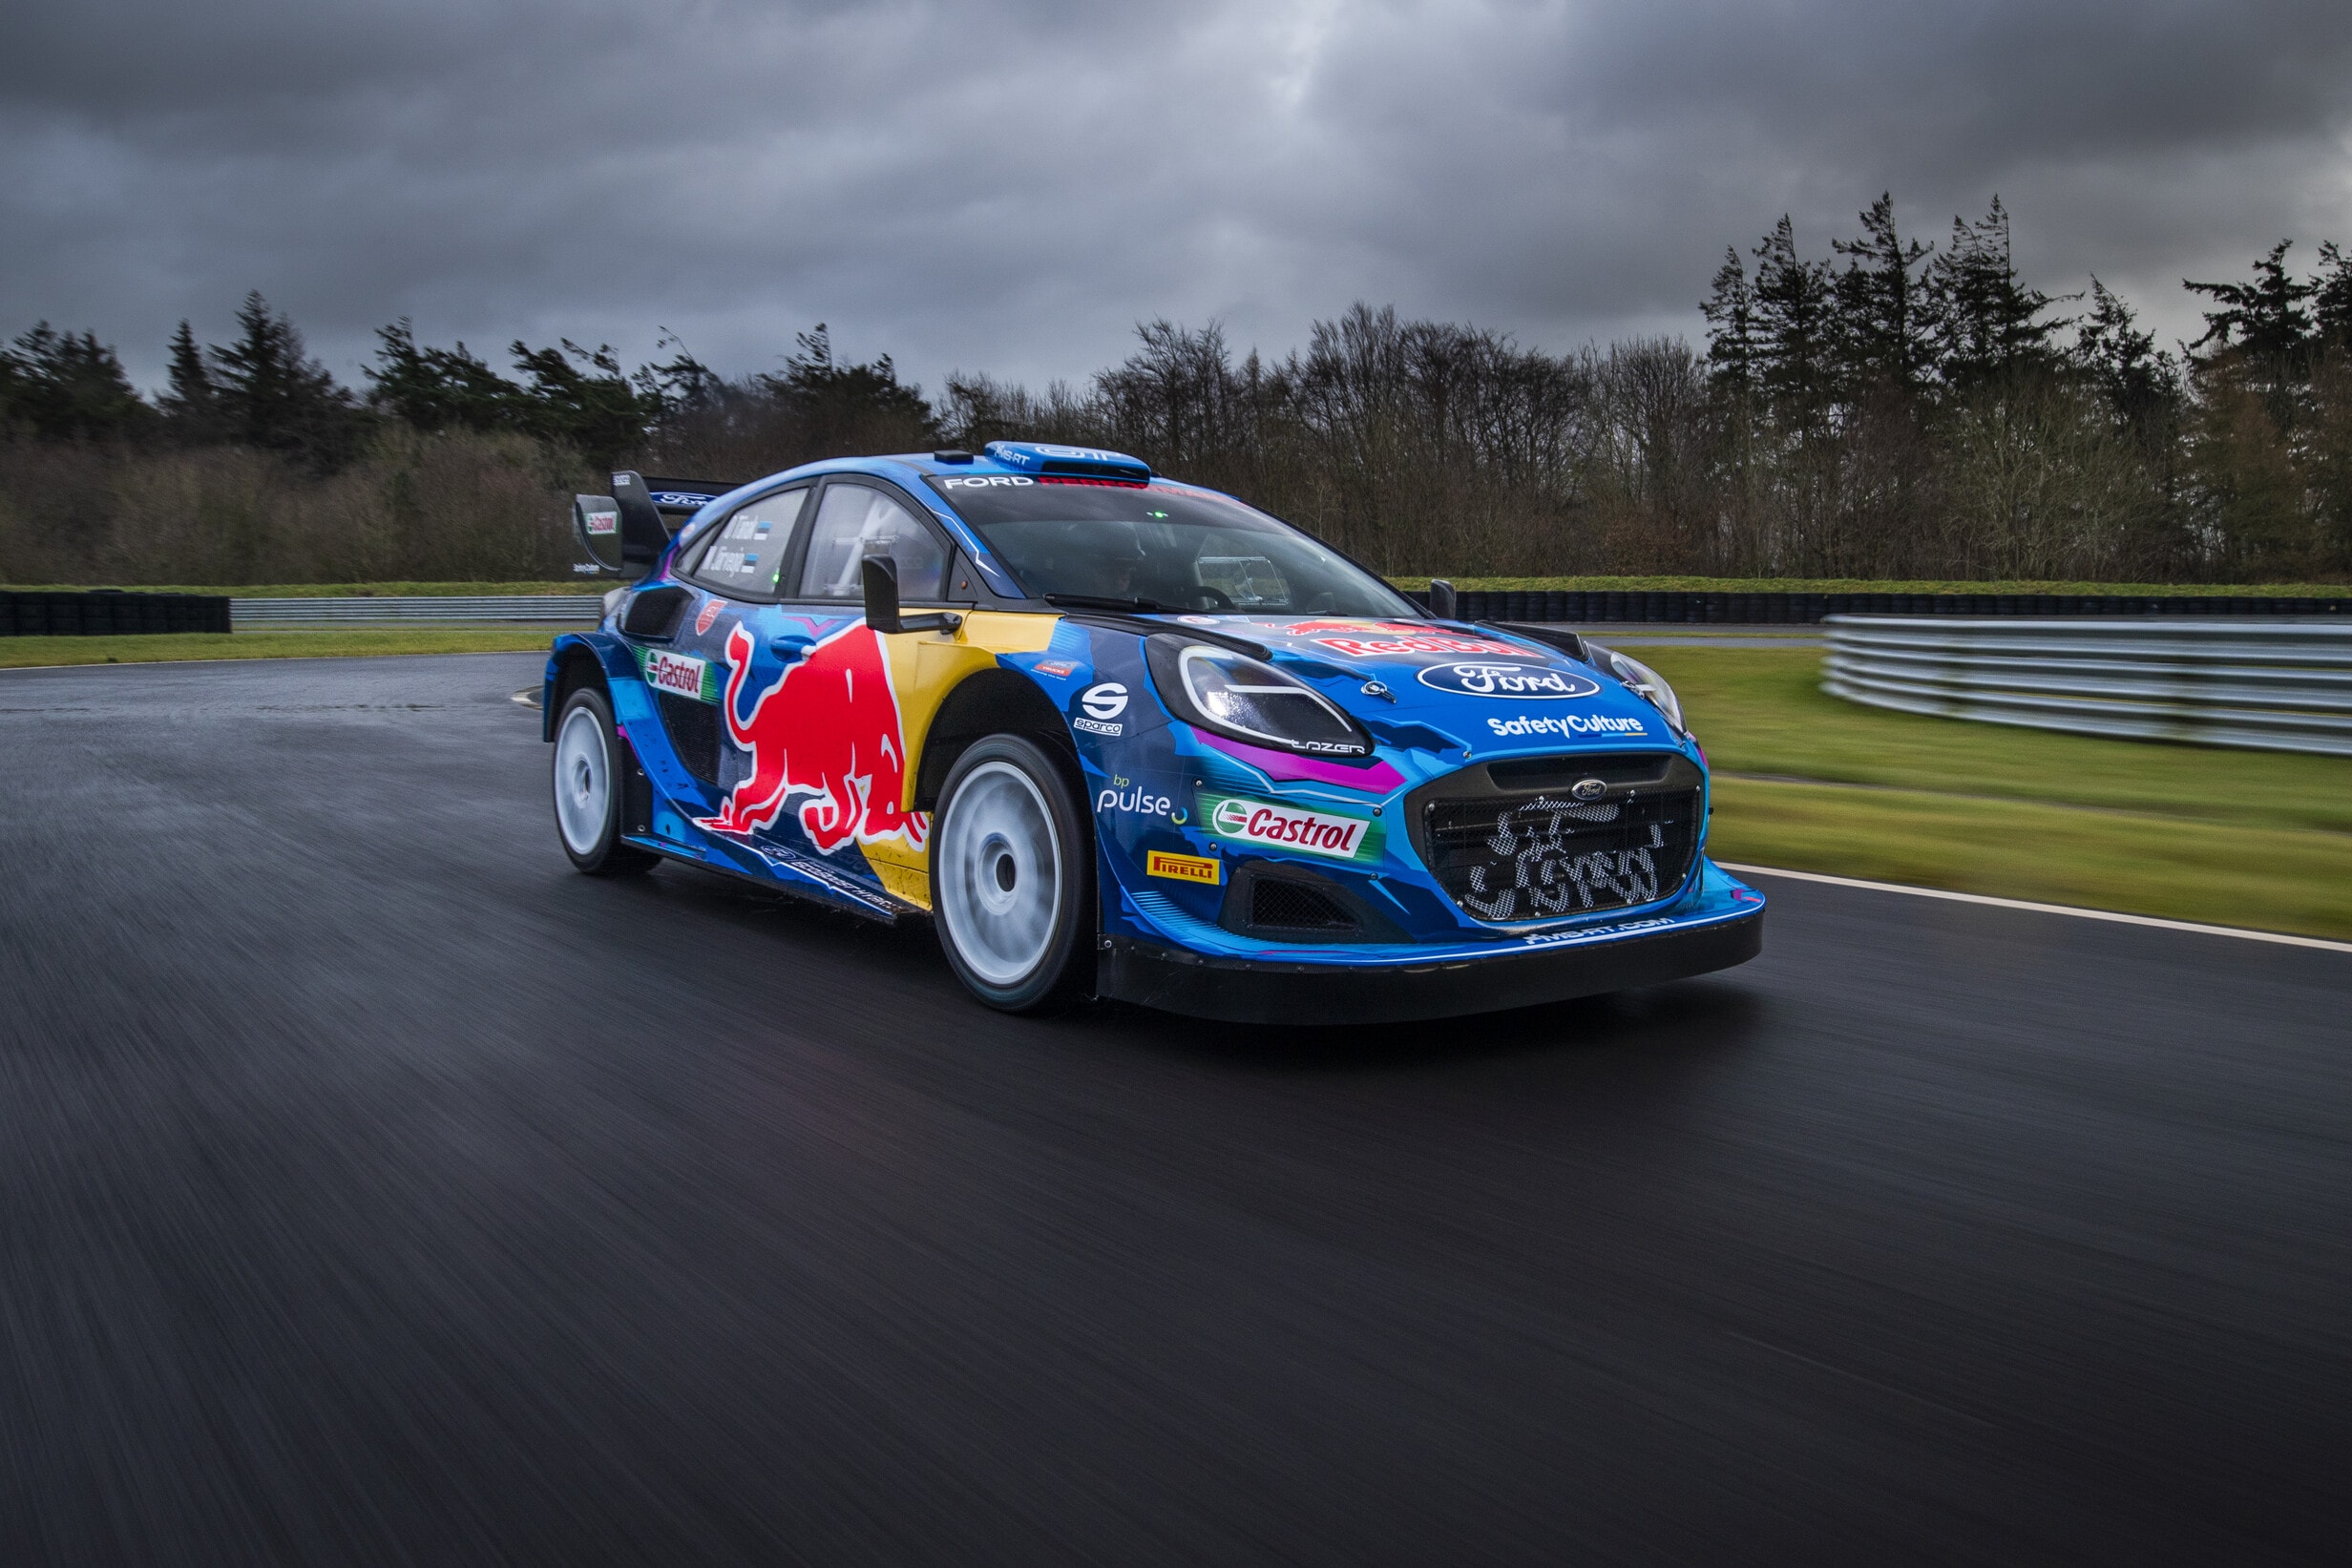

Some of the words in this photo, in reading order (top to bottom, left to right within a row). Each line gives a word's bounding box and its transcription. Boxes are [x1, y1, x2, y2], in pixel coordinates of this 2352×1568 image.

[943, 476, 1034, 490] FORD
[659, 656, 702, 694] Castrol
[1454, 666, 1575, 693] Ford
[1076, 719, 1122, 734] sparco
[1487, 715, 1644, 739] SafetyCulture
[1113, 774, 1130, 788] bp
[1582, 784, 1601, 796] Ford
[1097, 785, 1171, 817] pulse
[1248, 808, 1357, 851] Castrol
[1153, 856, 1213, 879] PIRELLI
